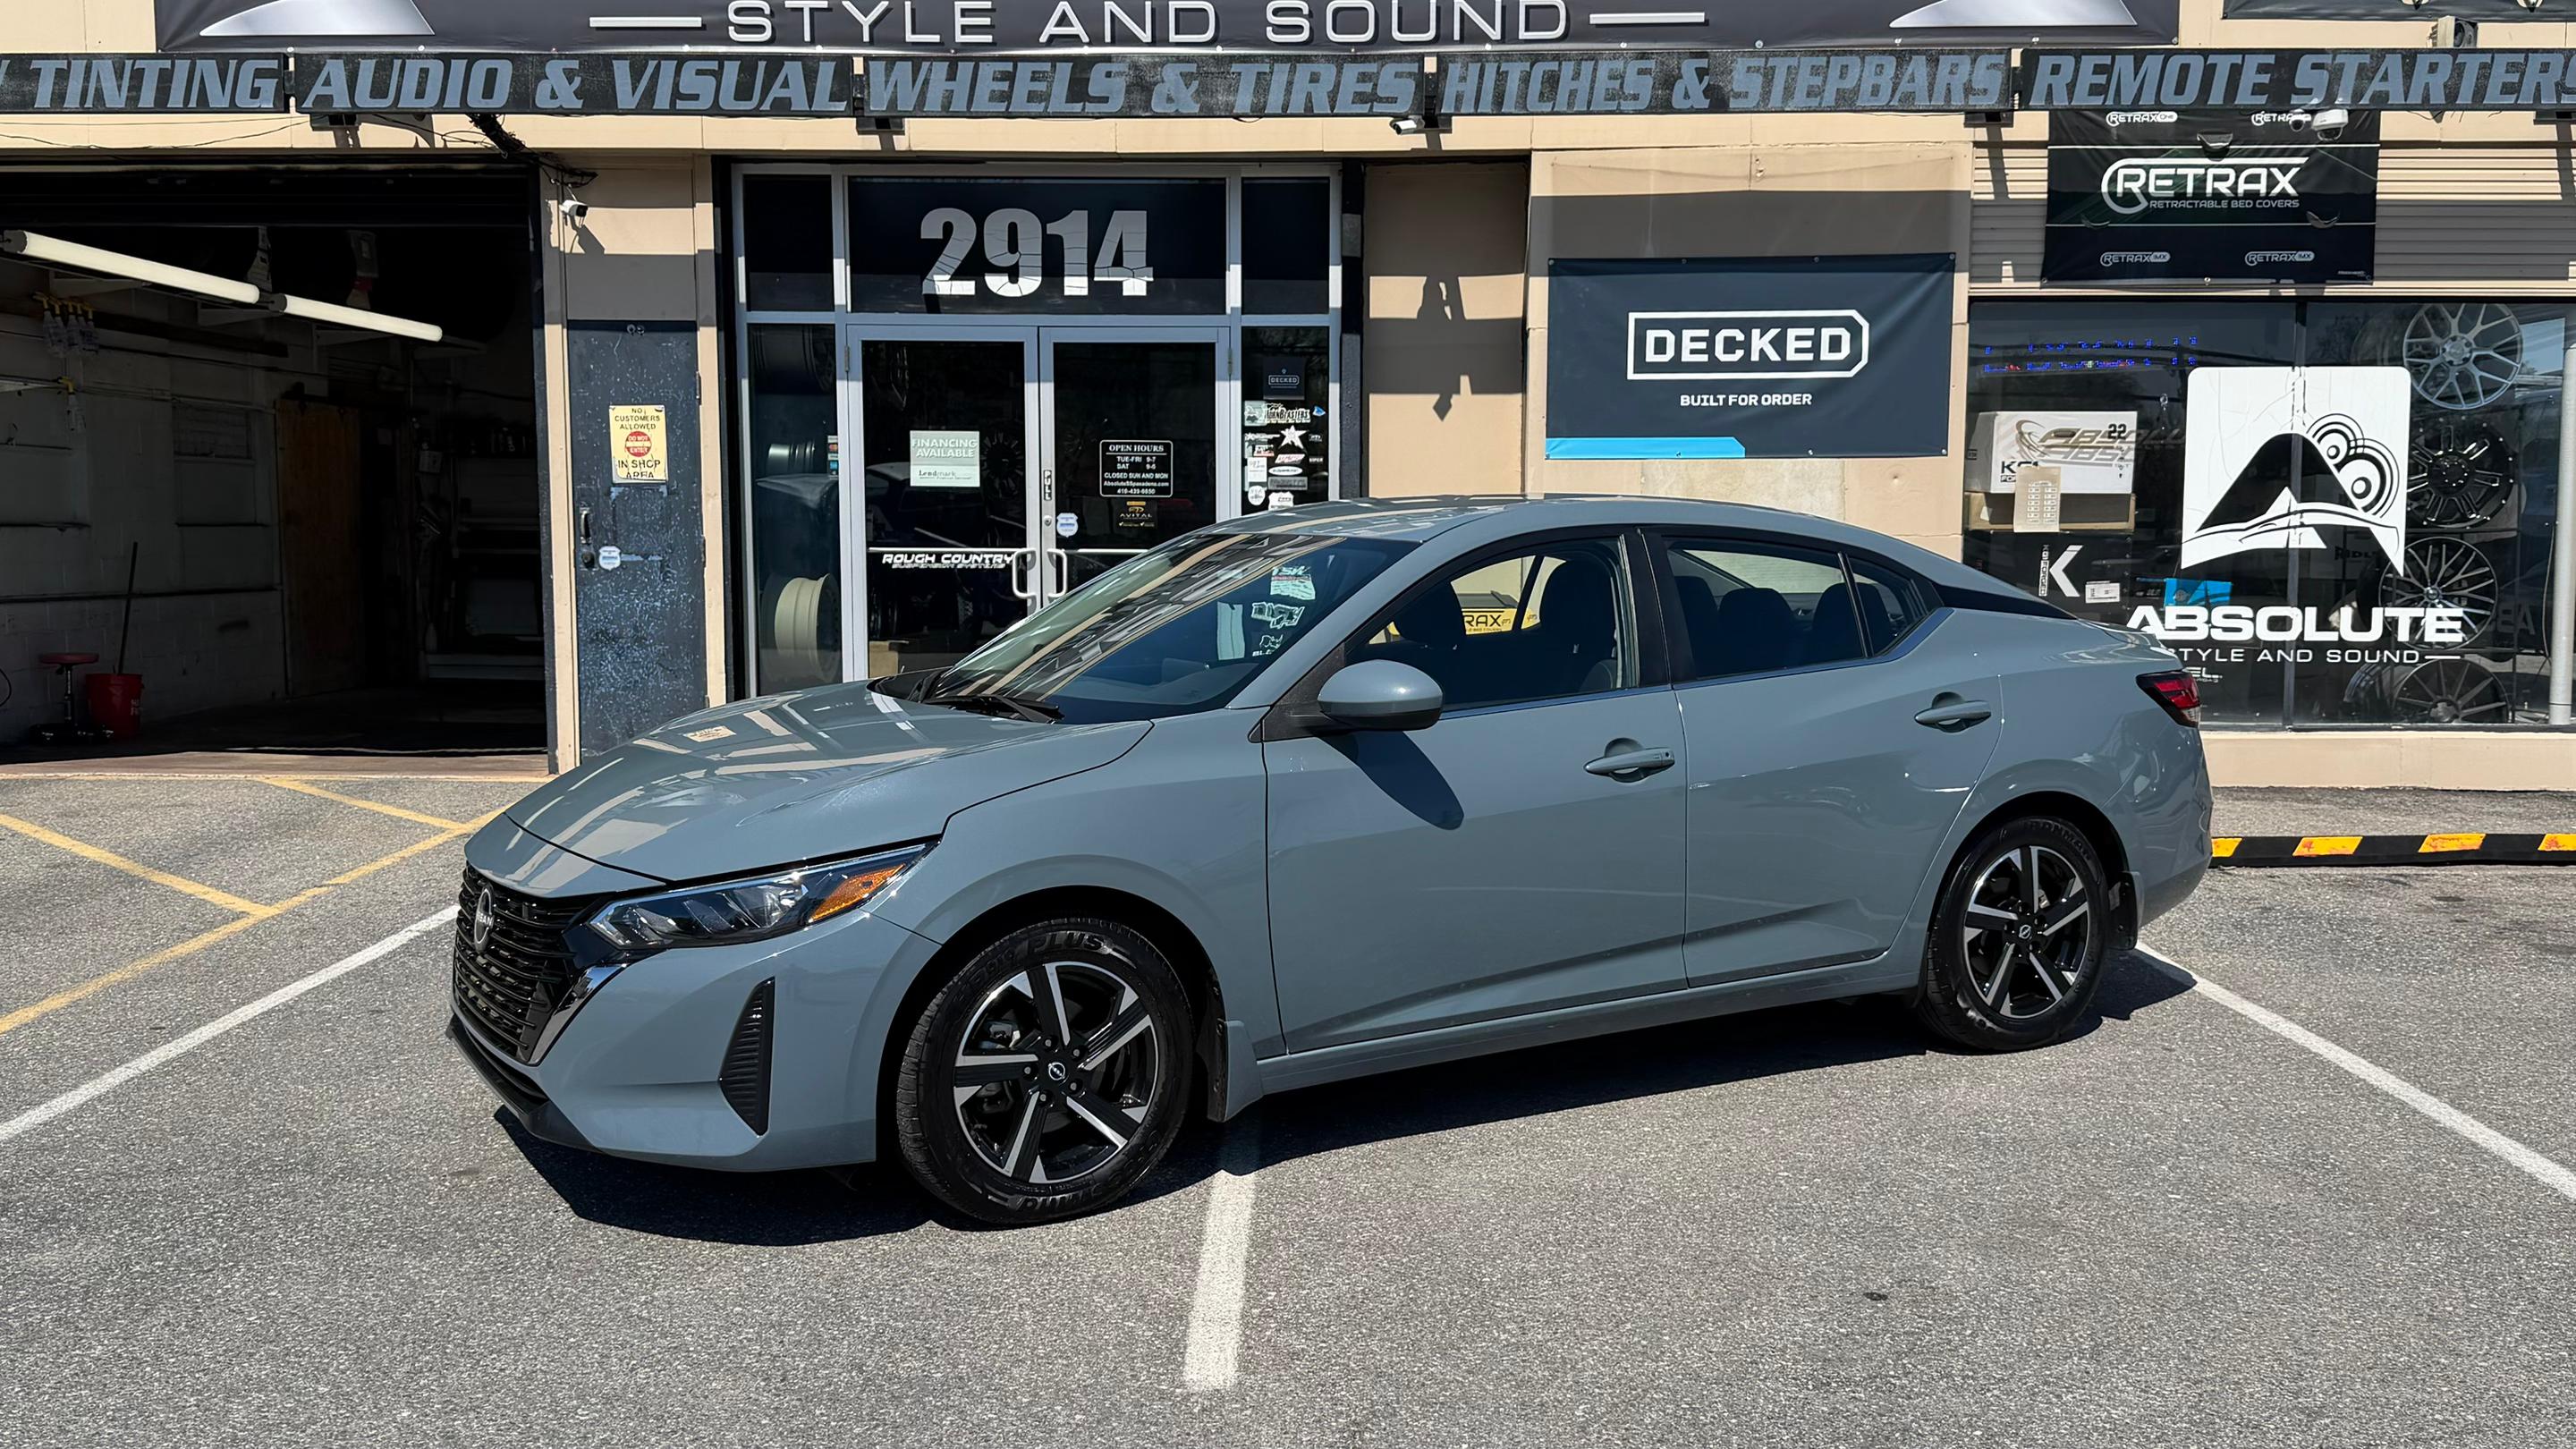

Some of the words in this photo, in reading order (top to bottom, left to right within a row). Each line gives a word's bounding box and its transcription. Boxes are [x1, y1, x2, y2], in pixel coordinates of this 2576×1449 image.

[728, 0, 993, 43] STYLE
[1038, 0, 1216, 43] AND
[1266, 0, 1567, 43] SOUND
[30, 59, 279, 109] TINTING
[301, 59, 514, 109] AUDIO
[536, 59, 585, 108] &
[612, 59, 849, 111] VISUAL
[867, 61, 1129, 113] WHEELS
[1150, 61, 1200, 113] &
[1230, 62, 1417, 114] TIRES
[1441, 59, 1655, 113] HITCHES
[1672, 59, 1710, 109] &
[1728, 55, 2007, 108] STEPBARS
[2028, 54, 2276, 106] REMOTE
[2107, 112, 2157, 123] RETRAX
[2102, 158, 2303, 199] RETRAX
[2149, 199, 2228, 208] RETRACTABLE
[2231, 199, 2252, 208] BED
[2256, 199, 2300, 208] COVERS
[919, 208, 1154, 297] 2914
[2101, 252, 2150, 264] RETRAX
[2246, 251, 2295, 263] RETRAX
[1645, 327, 1851, 362] DECKED
[1681, 394, 1726, 406] BUILT
[1728, 394, 1758, 406] FOR
[1761, 394, 1812, 405] ORDER
[911, 438, 978, 447] FINANCING
[916, 448, 974, 457] AVAILABLE
[617, 460, 628, 468] IN
[631, 460, 661, 468] SHOP
[1044, 470, 1052, 500] PULL
[882, 554, 936, 564] ROUGH
[941, 554, 1013, 564] COUNTRY
[2127, 606, 2463, 642] ABSOLUTE
[2258, 648, 2313, 663] AND
[2326, 649, 2419, 664] SOUND
